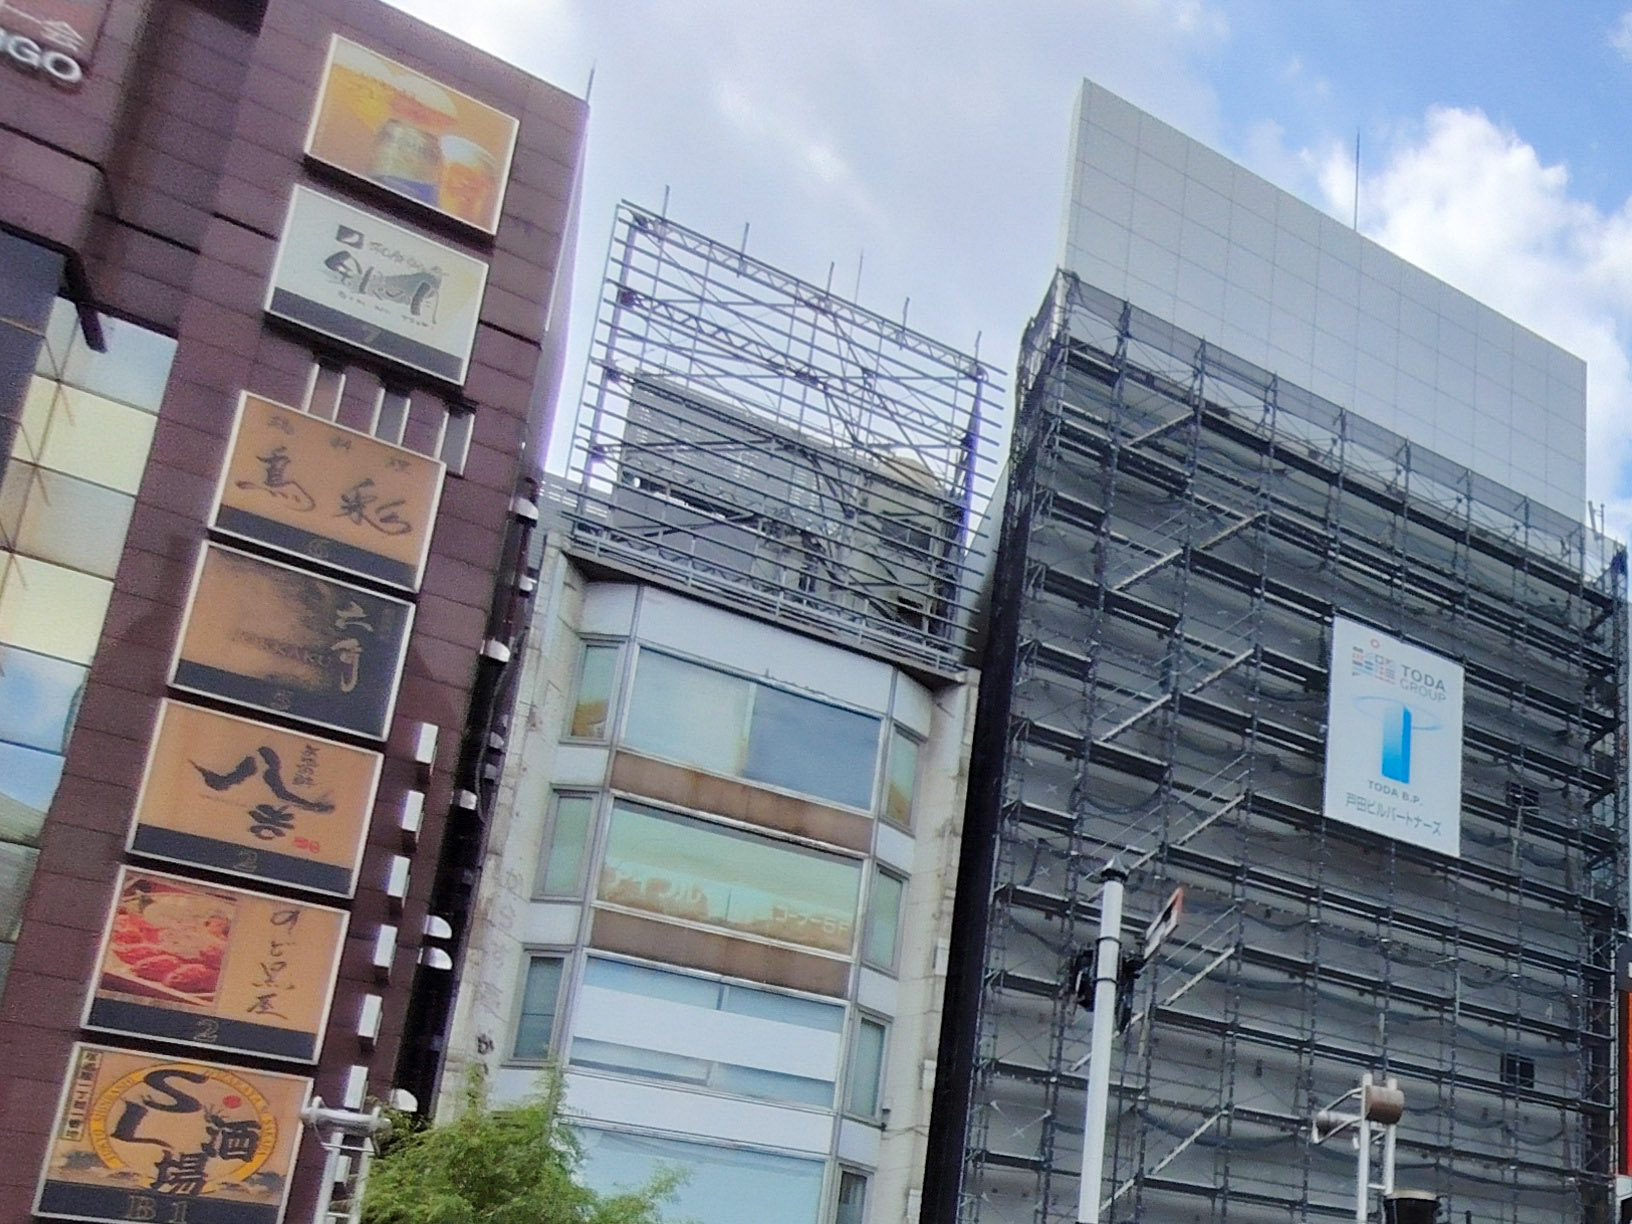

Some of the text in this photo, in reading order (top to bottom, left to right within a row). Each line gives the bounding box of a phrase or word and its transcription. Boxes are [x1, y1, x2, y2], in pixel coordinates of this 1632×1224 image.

[1402, 664, 1446, 693] TODA
[1400, 679, 1447, 702] GROUP
[1368, 780, 1399, 798] TODA
